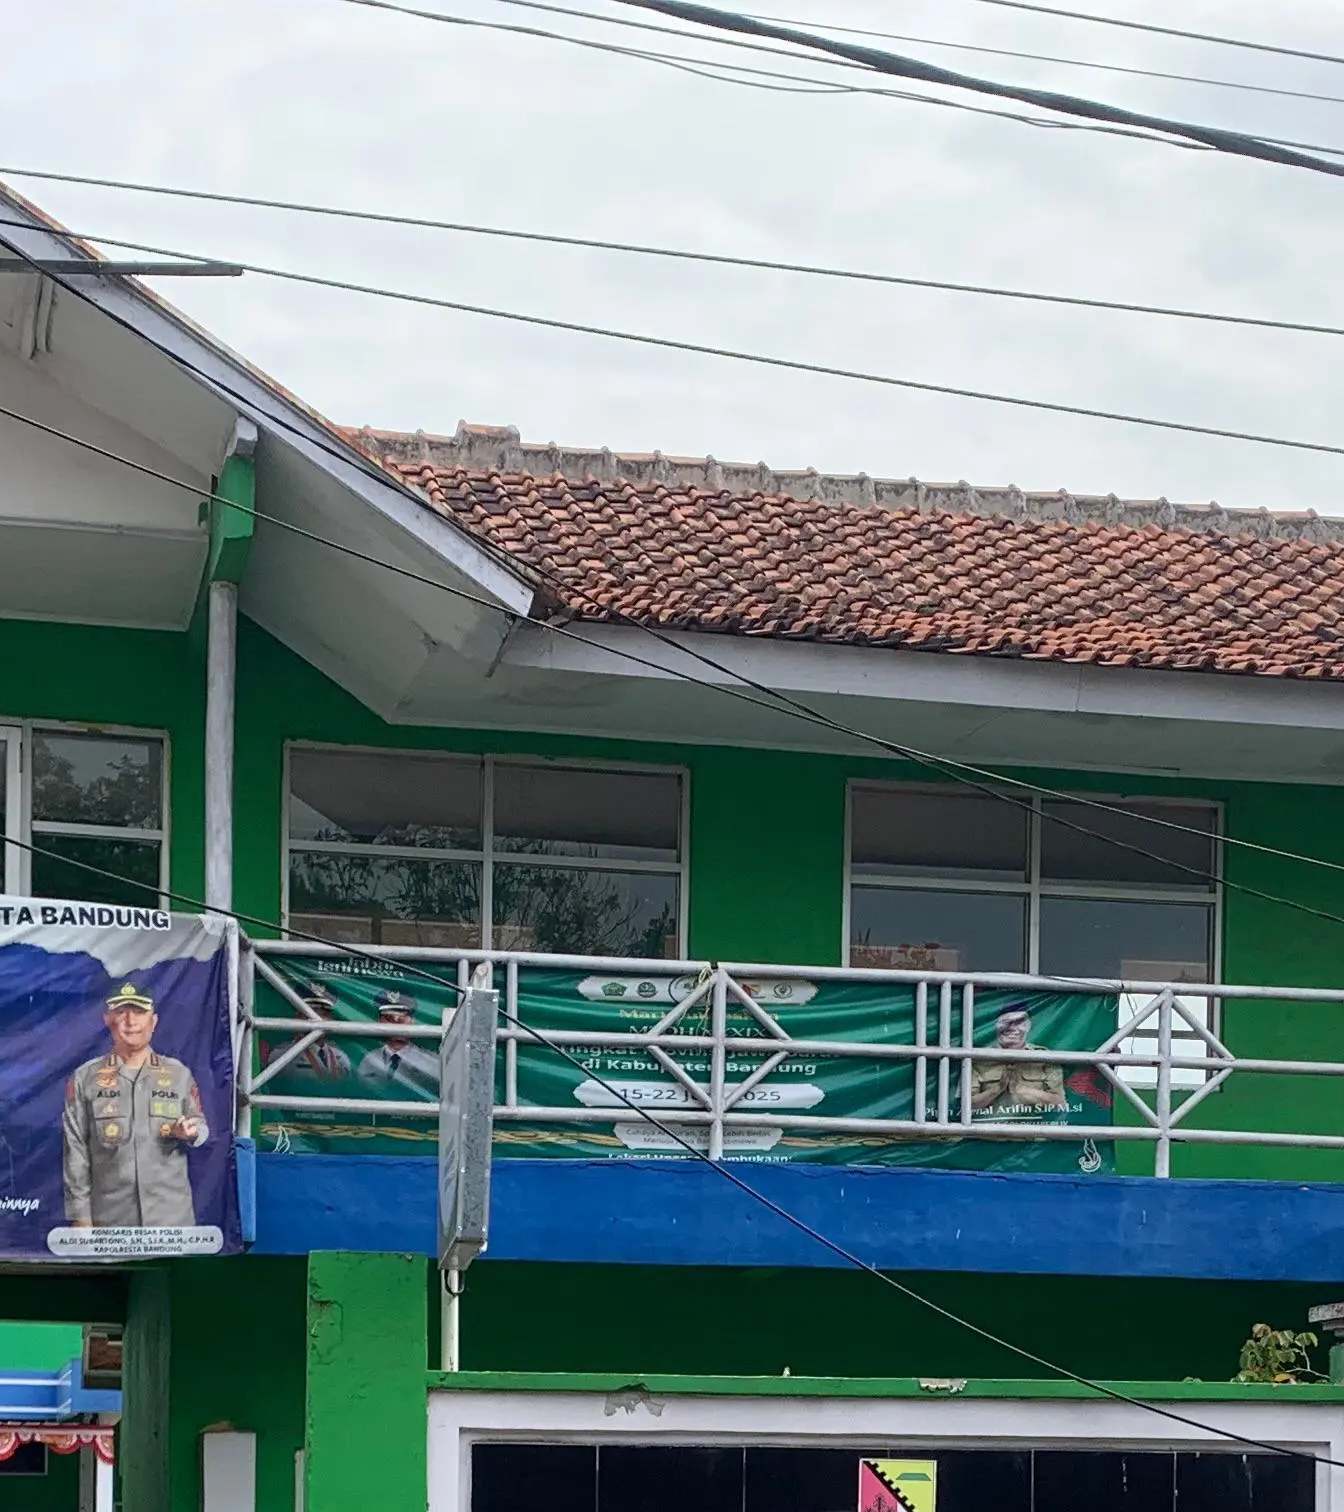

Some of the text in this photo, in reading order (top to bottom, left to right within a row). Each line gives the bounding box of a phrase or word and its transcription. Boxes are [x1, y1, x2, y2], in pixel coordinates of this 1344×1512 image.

[41, 906, 170, 929] BANDUNG
[581, 1059, 600, 1069] di
[726, 1062, 816, 1076] Banung
[620, 1088, 677, 1100] 15-22
[736, 1090, 781, 1101] 025
